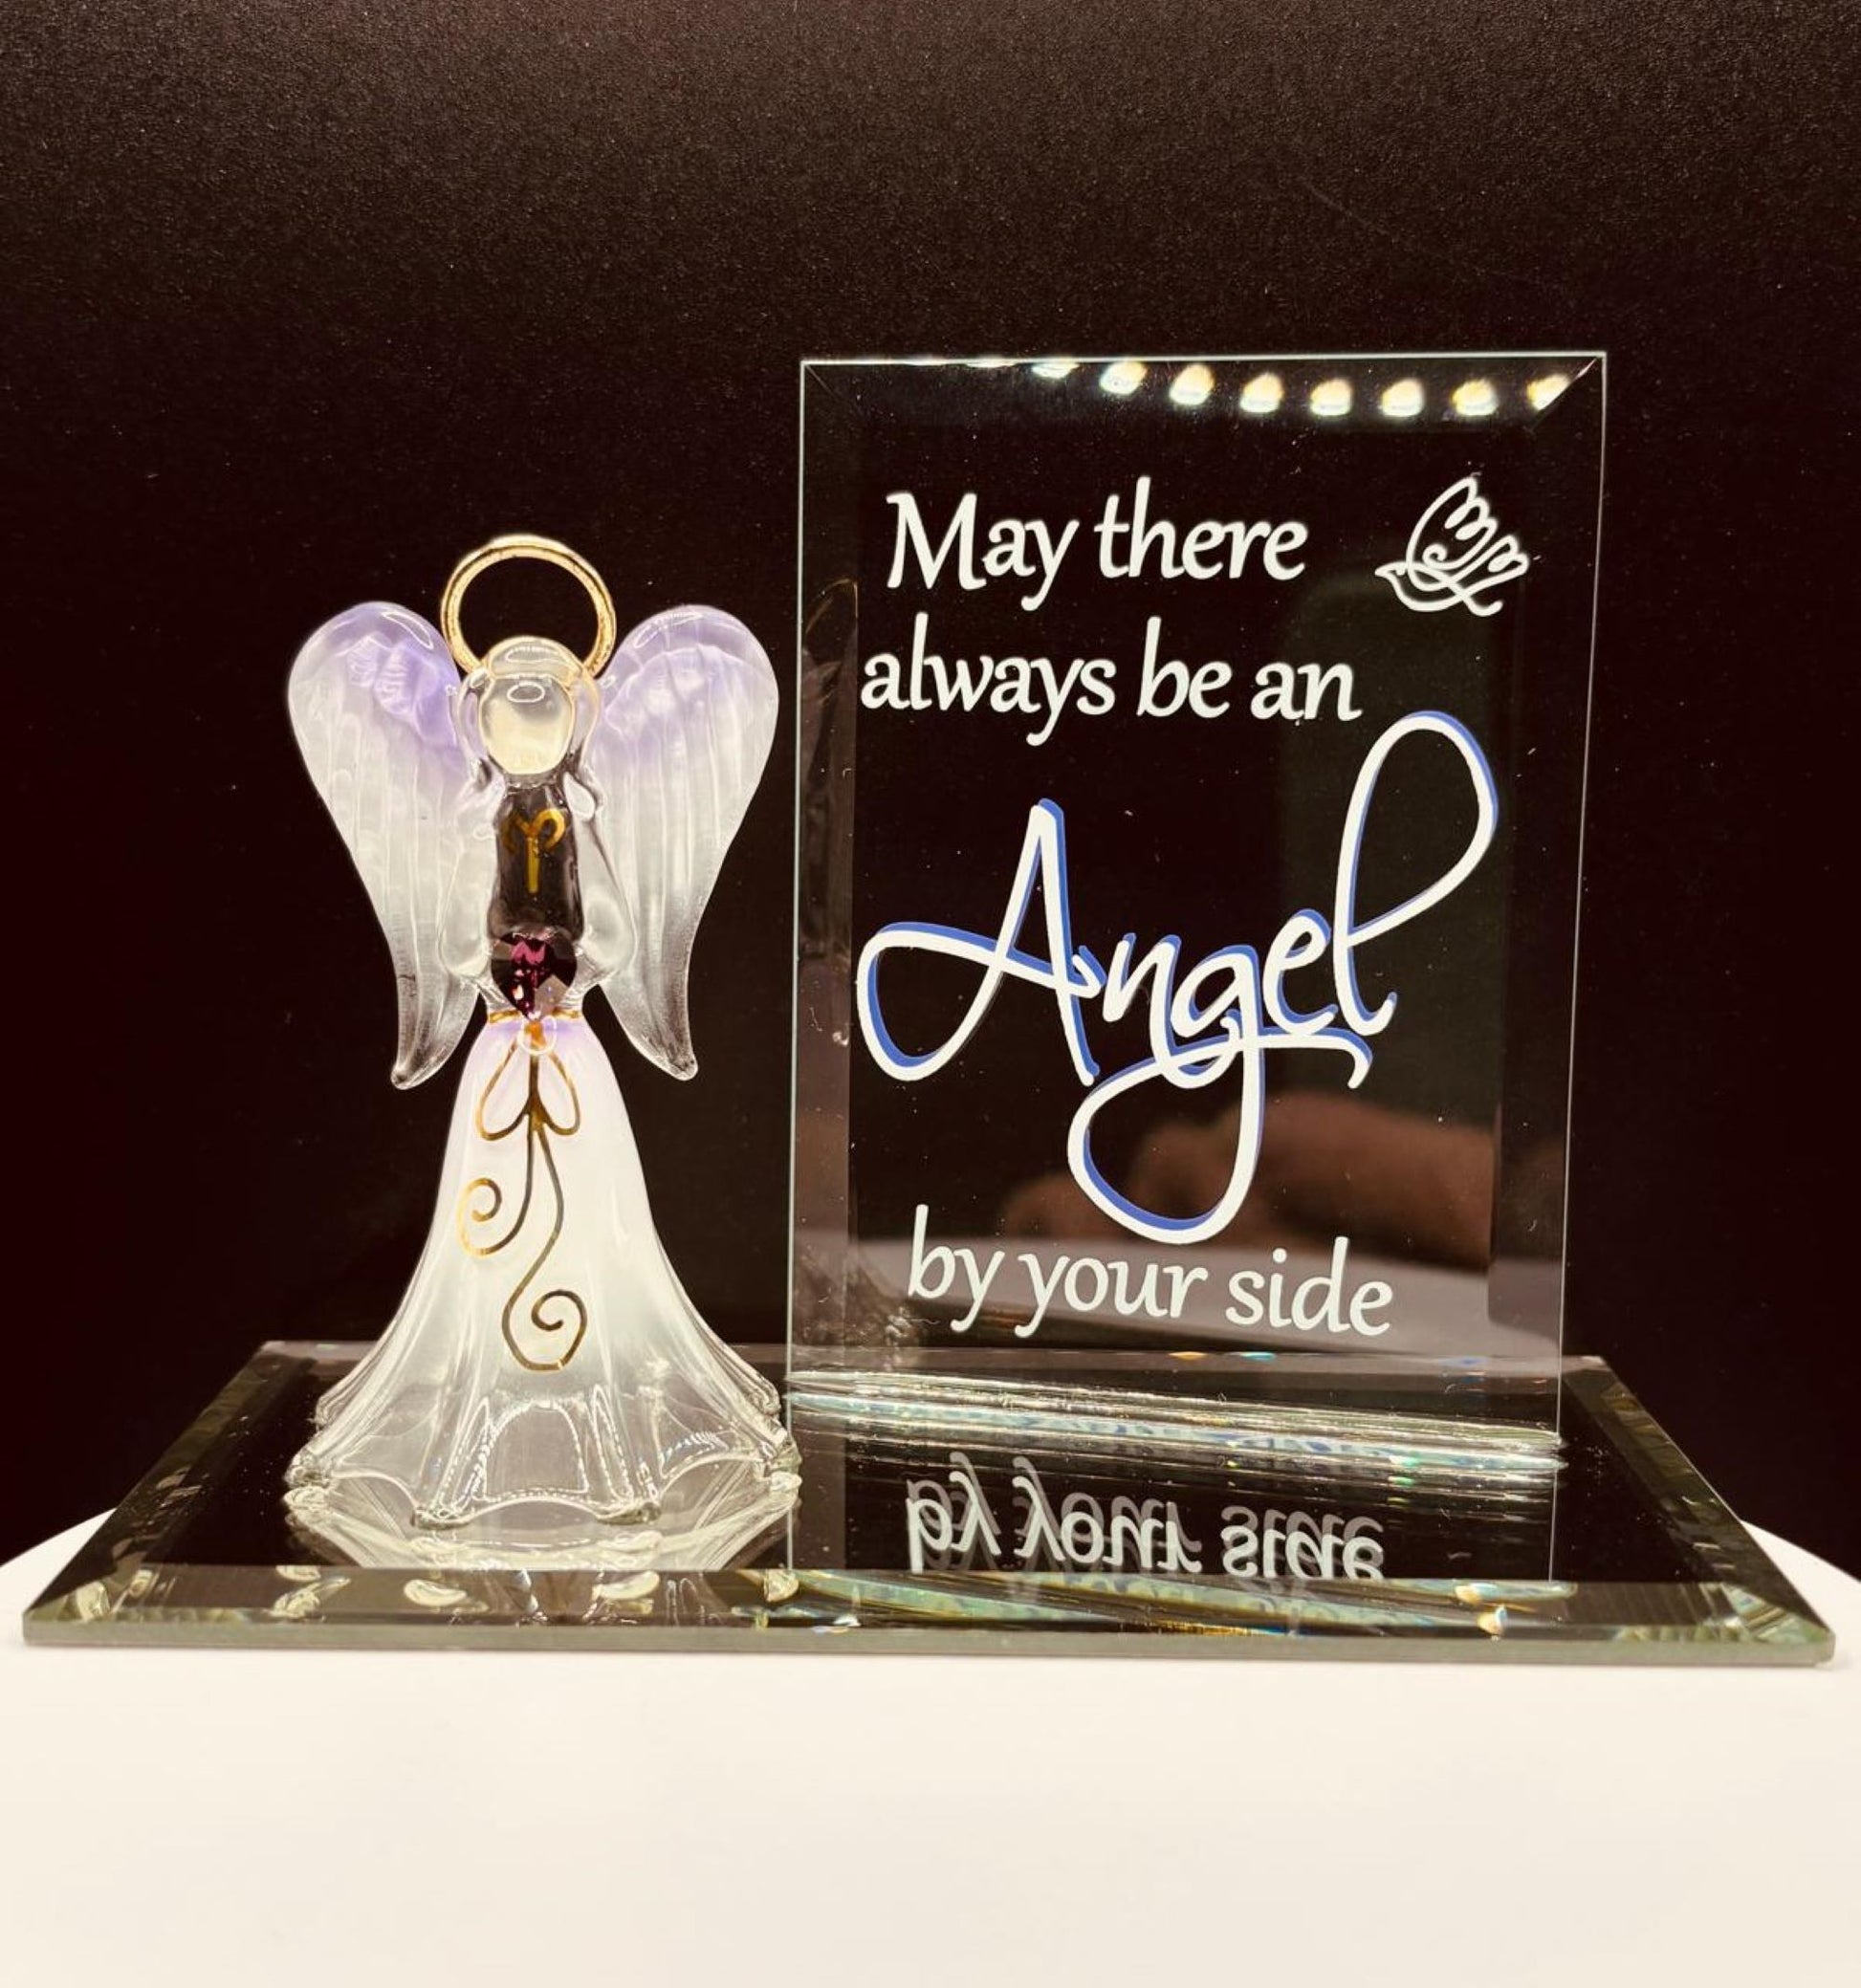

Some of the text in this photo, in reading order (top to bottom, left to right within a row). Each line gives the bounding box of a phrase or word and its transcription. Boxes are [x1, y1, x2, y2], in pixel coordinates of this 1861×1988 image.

[885, 475, 1309, 612] May there
[860, 611, 1364, 747] always be an
[854, 710, 1500, 1246] Angel
[907, 1203, 1394, 1339] by your side
